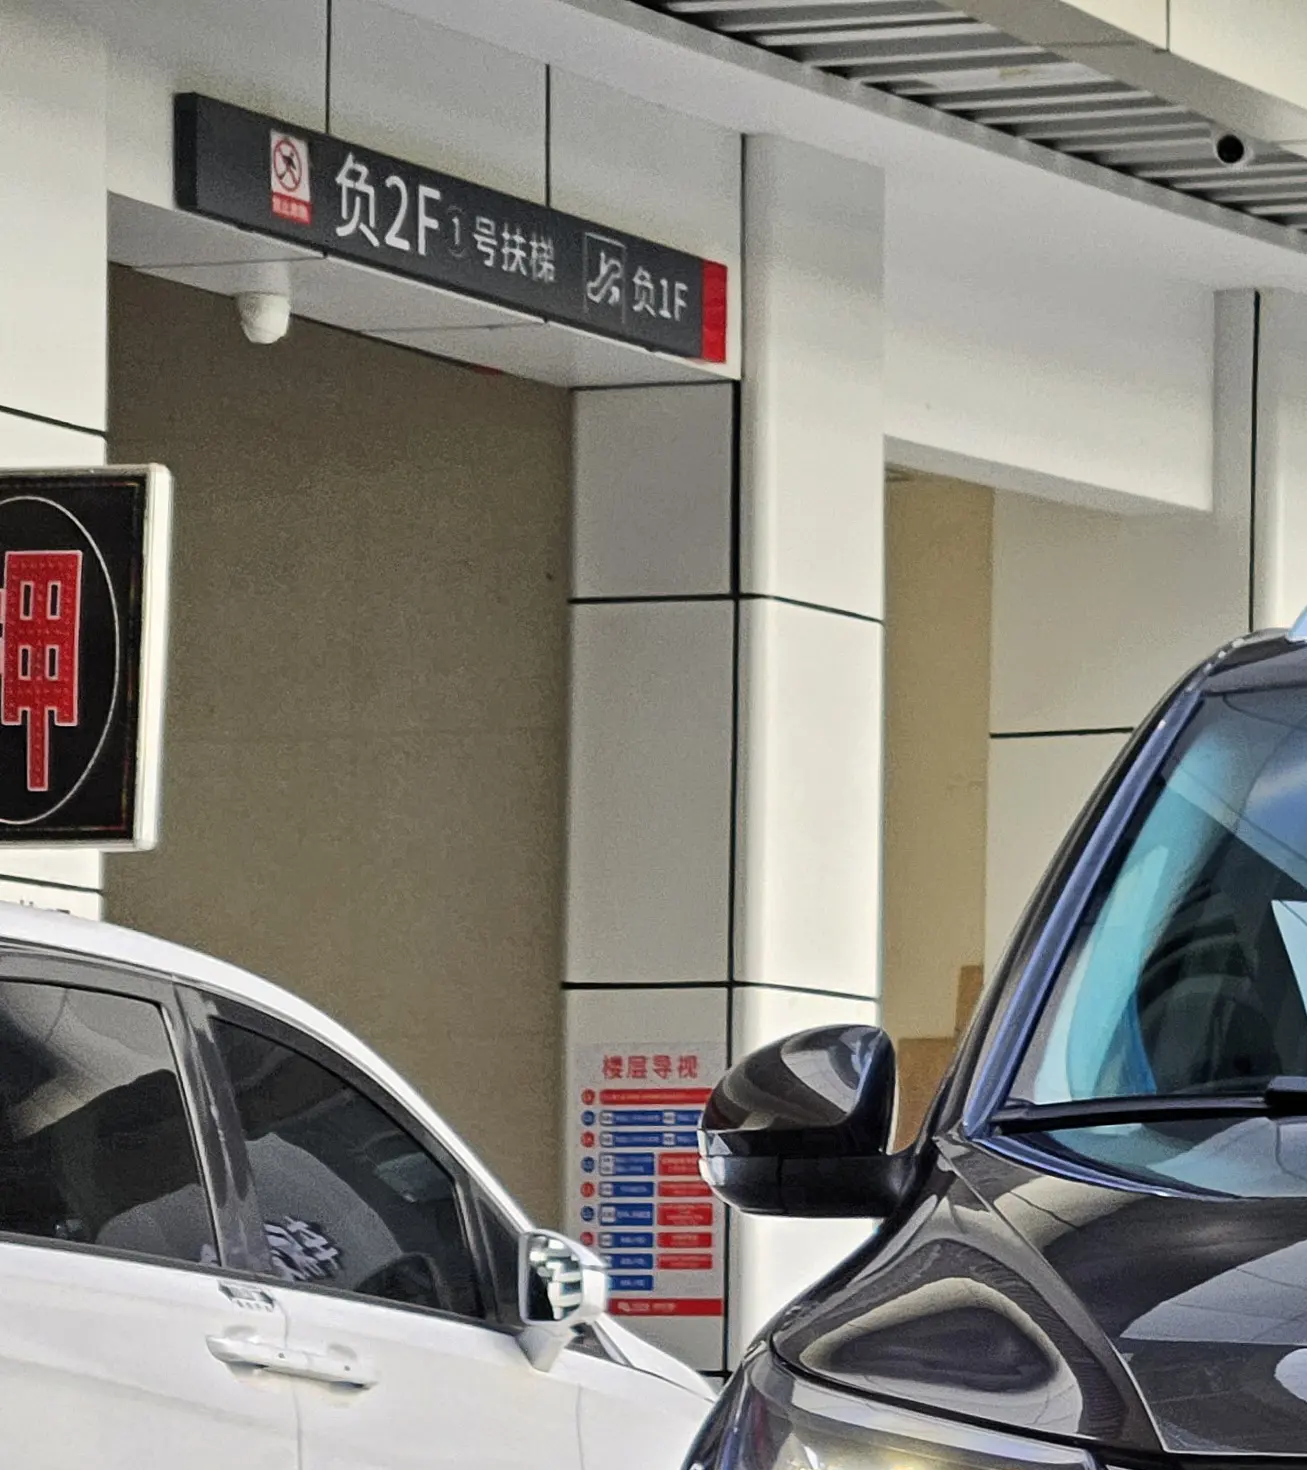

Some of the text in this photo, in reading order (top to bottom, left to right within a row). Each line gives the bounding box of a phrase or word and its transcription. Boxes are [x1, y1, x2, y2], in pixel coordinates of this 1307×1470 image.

[334, 151, 442, 256] 负2F
[631, 265, 689, 322] 负1F
[602, 1054, 698, 1080] 楼层导视
